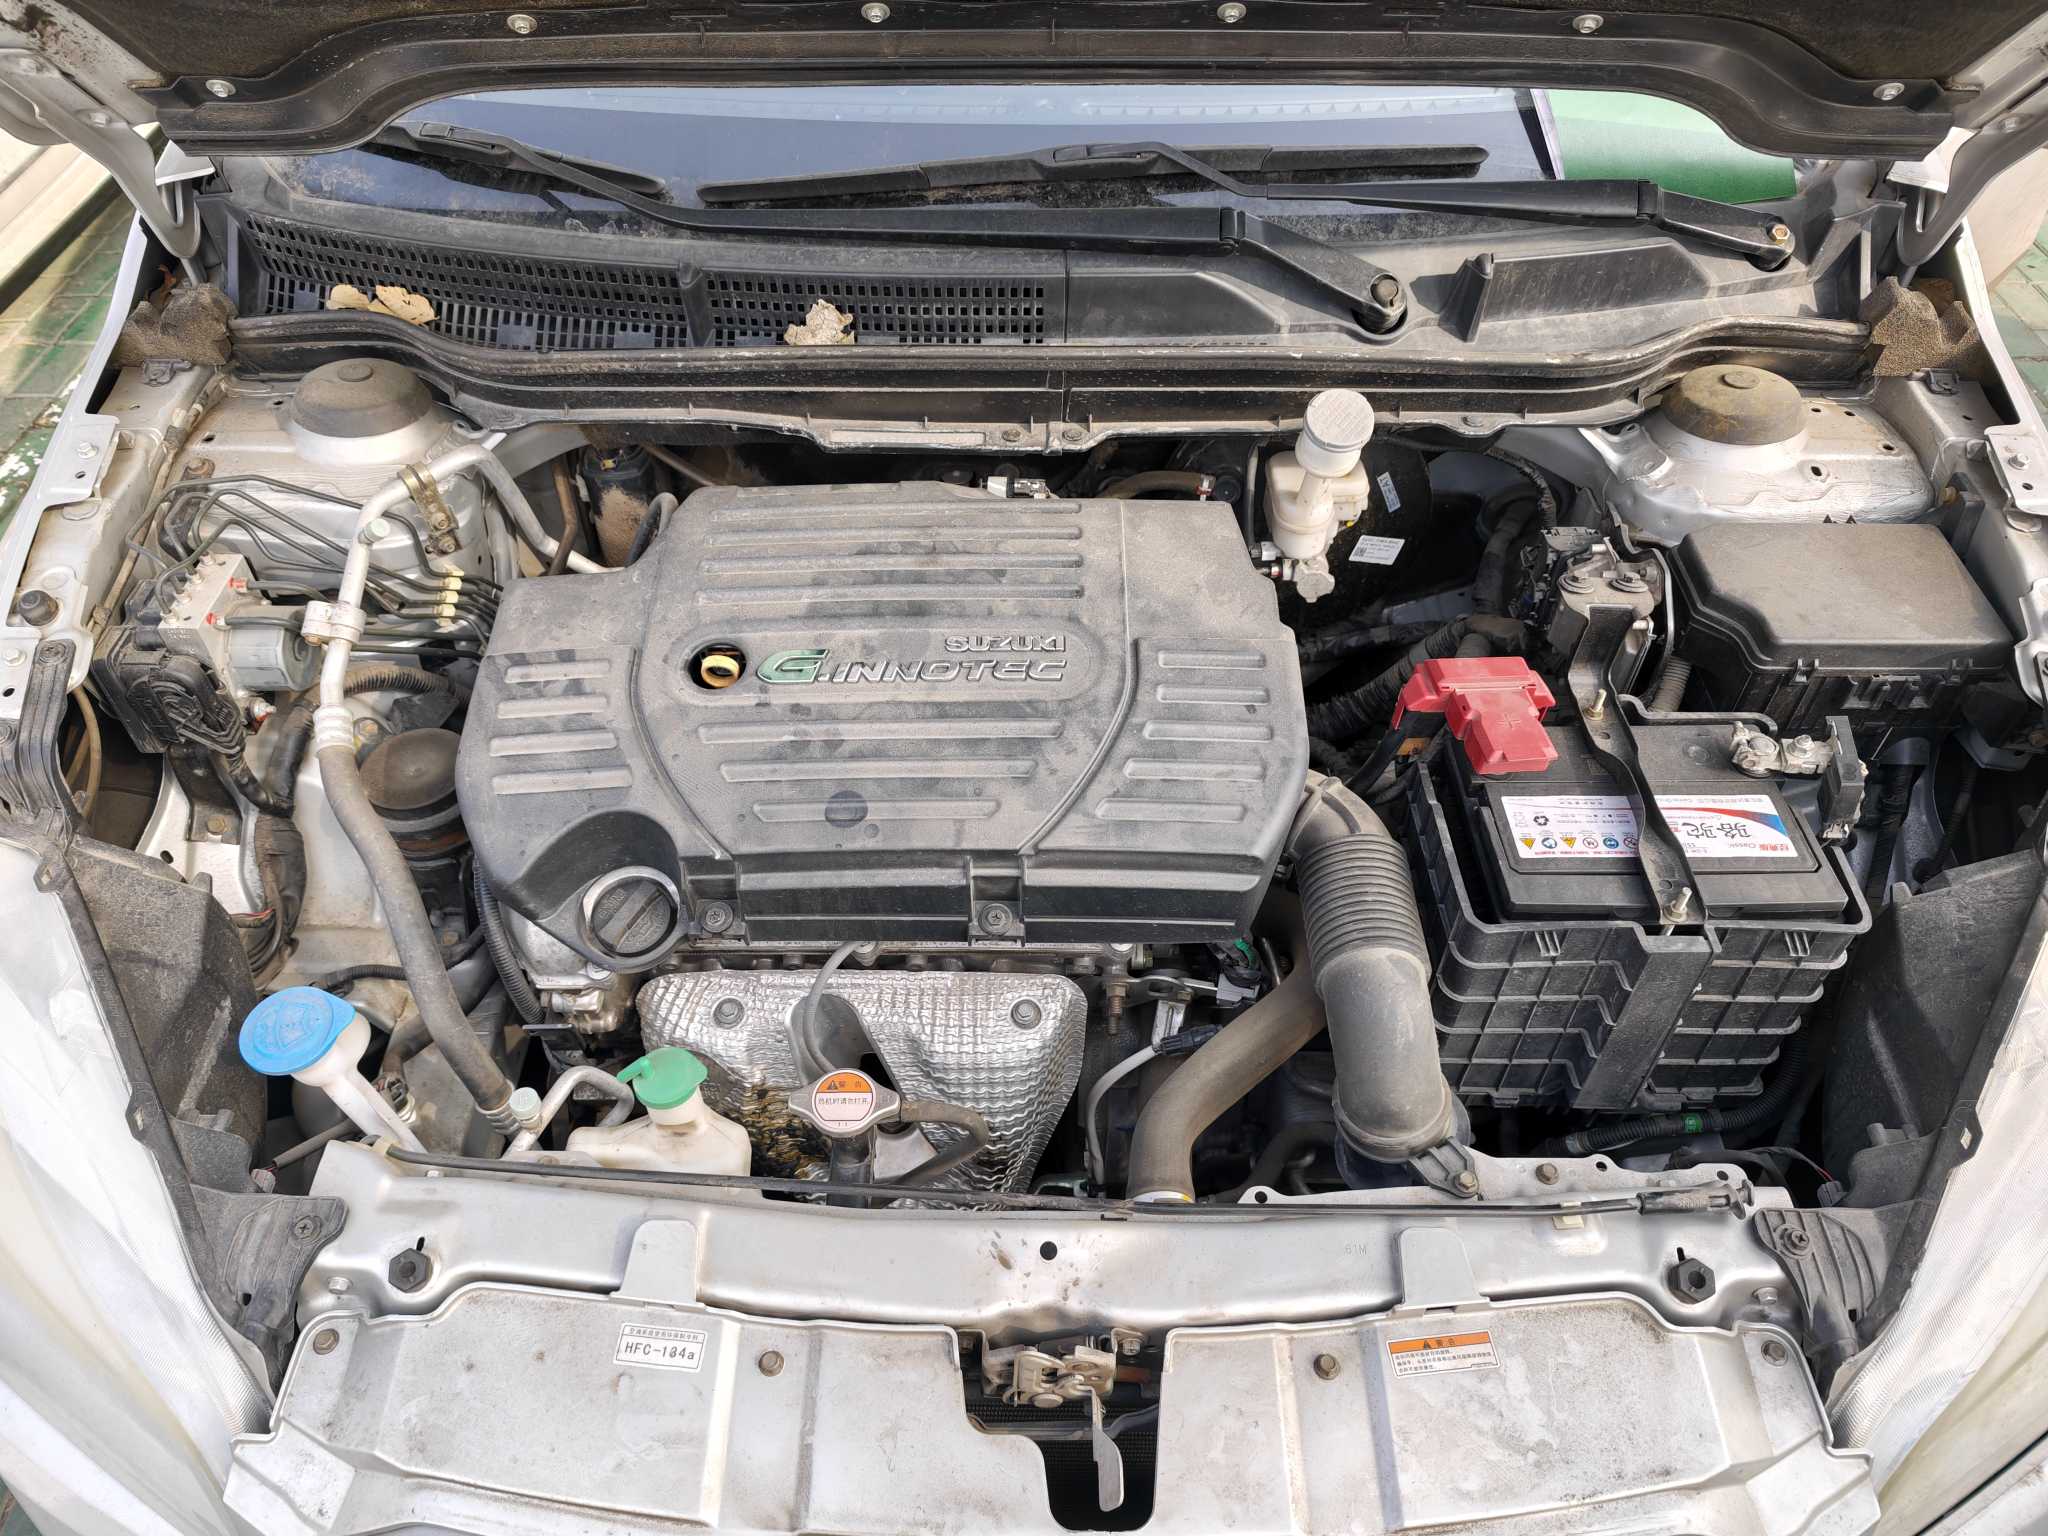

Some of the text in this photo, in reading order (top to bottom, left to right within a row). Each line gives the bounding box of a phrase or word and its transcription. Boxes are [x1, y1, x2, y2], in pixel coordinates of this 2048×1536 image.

[945, 634, 1066, 652] SUZUKI
[1682, 822, 1752, 839] 骆驼
[624, 1341, 695, 1360] HFC-134a
